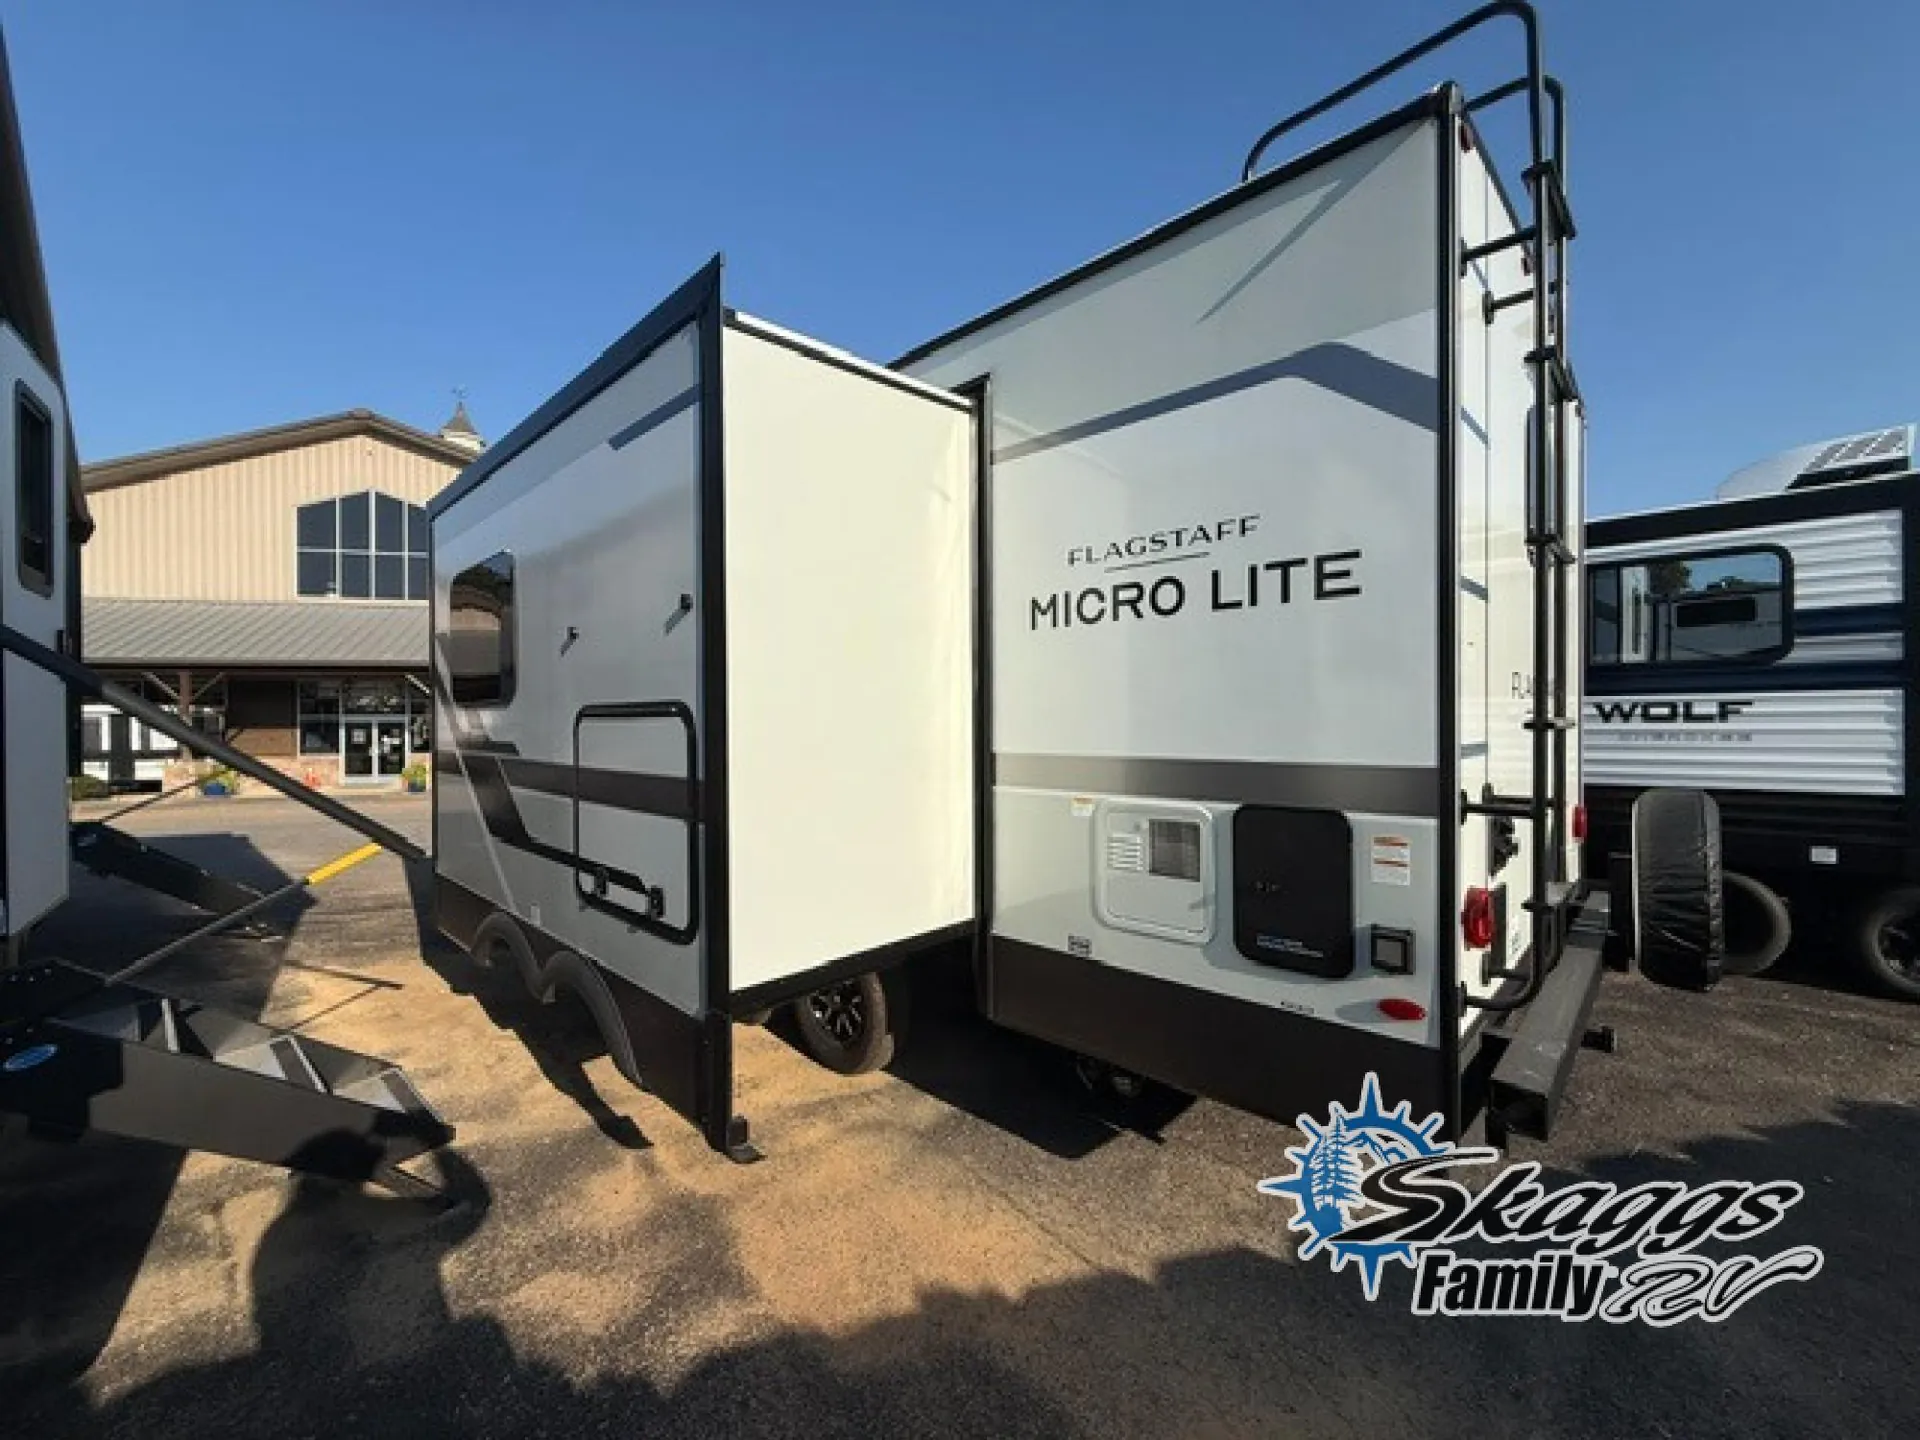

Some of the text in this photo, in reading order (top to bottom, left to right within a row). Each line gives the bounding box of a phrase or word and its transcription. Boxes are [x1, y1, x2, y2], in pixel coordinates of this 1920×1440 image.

[1067, 513, 1261, 567] FLAGSTAFF
[1030, 548, 1362, 631] MICRO LITE
[1592, 700, 1754, 724] WOLF
